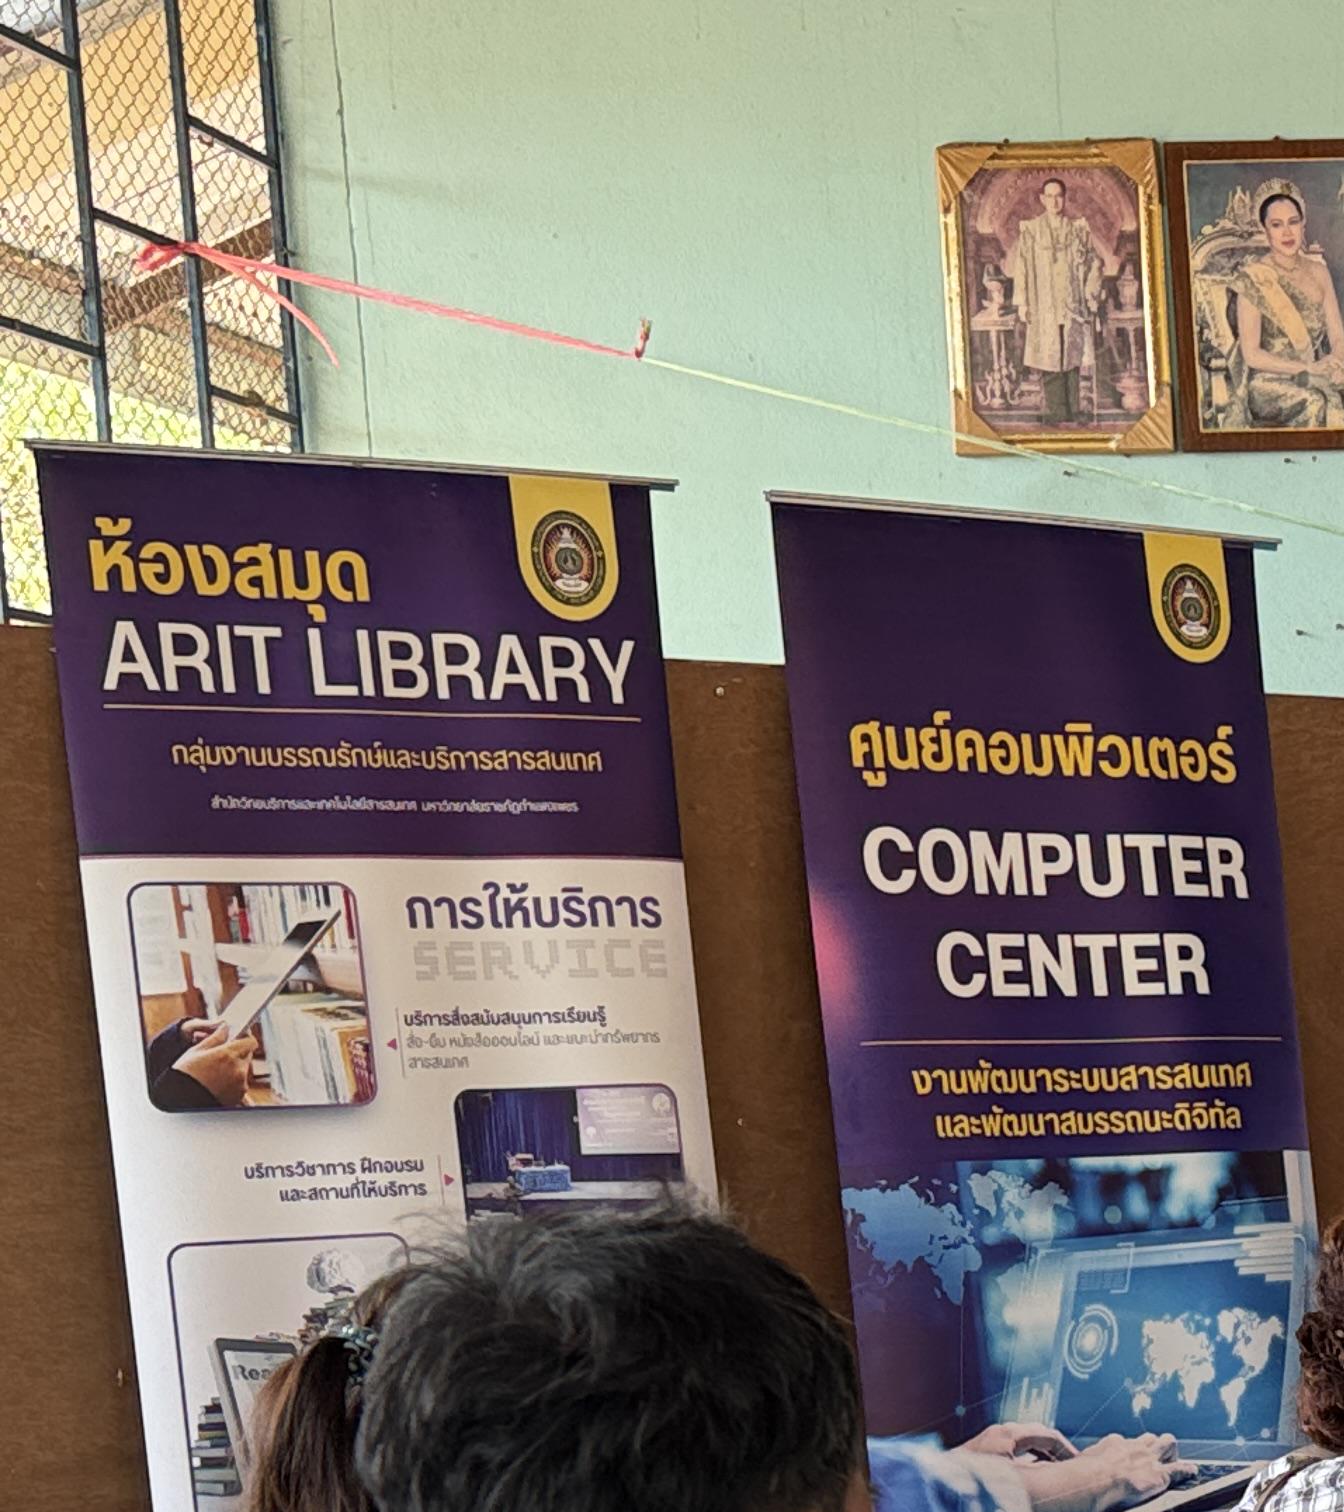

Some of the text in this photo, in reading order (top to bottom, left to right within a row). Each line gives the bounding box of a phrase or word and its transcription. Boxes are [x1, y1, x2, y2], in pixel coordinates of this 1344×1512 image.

[87, 517, 372, 622] ห้องสมุด
[103, 621, 636, 704] ARIT LIBRARY
[171, 738, 603, 776] กลุ่มงานบรรณรักษ์และบริการสารสนเทศ
[849, 711, 1238, 788] ศูนย์คอมพิวเตอร์
[862, 826, 1250, 900] COMPUTER
[405, 881, 664, 932] การให้บริการ
[412, 938, 670, 982] SERVICE
[936, 931, 1211, 999] CENTER
[911, 1058, 1253, 1098] งานพัฒนาระบบสารสนเทศ
[935, 1098, 1242, 1140] และพัฒนาสมรรถนะดิจิทัล
